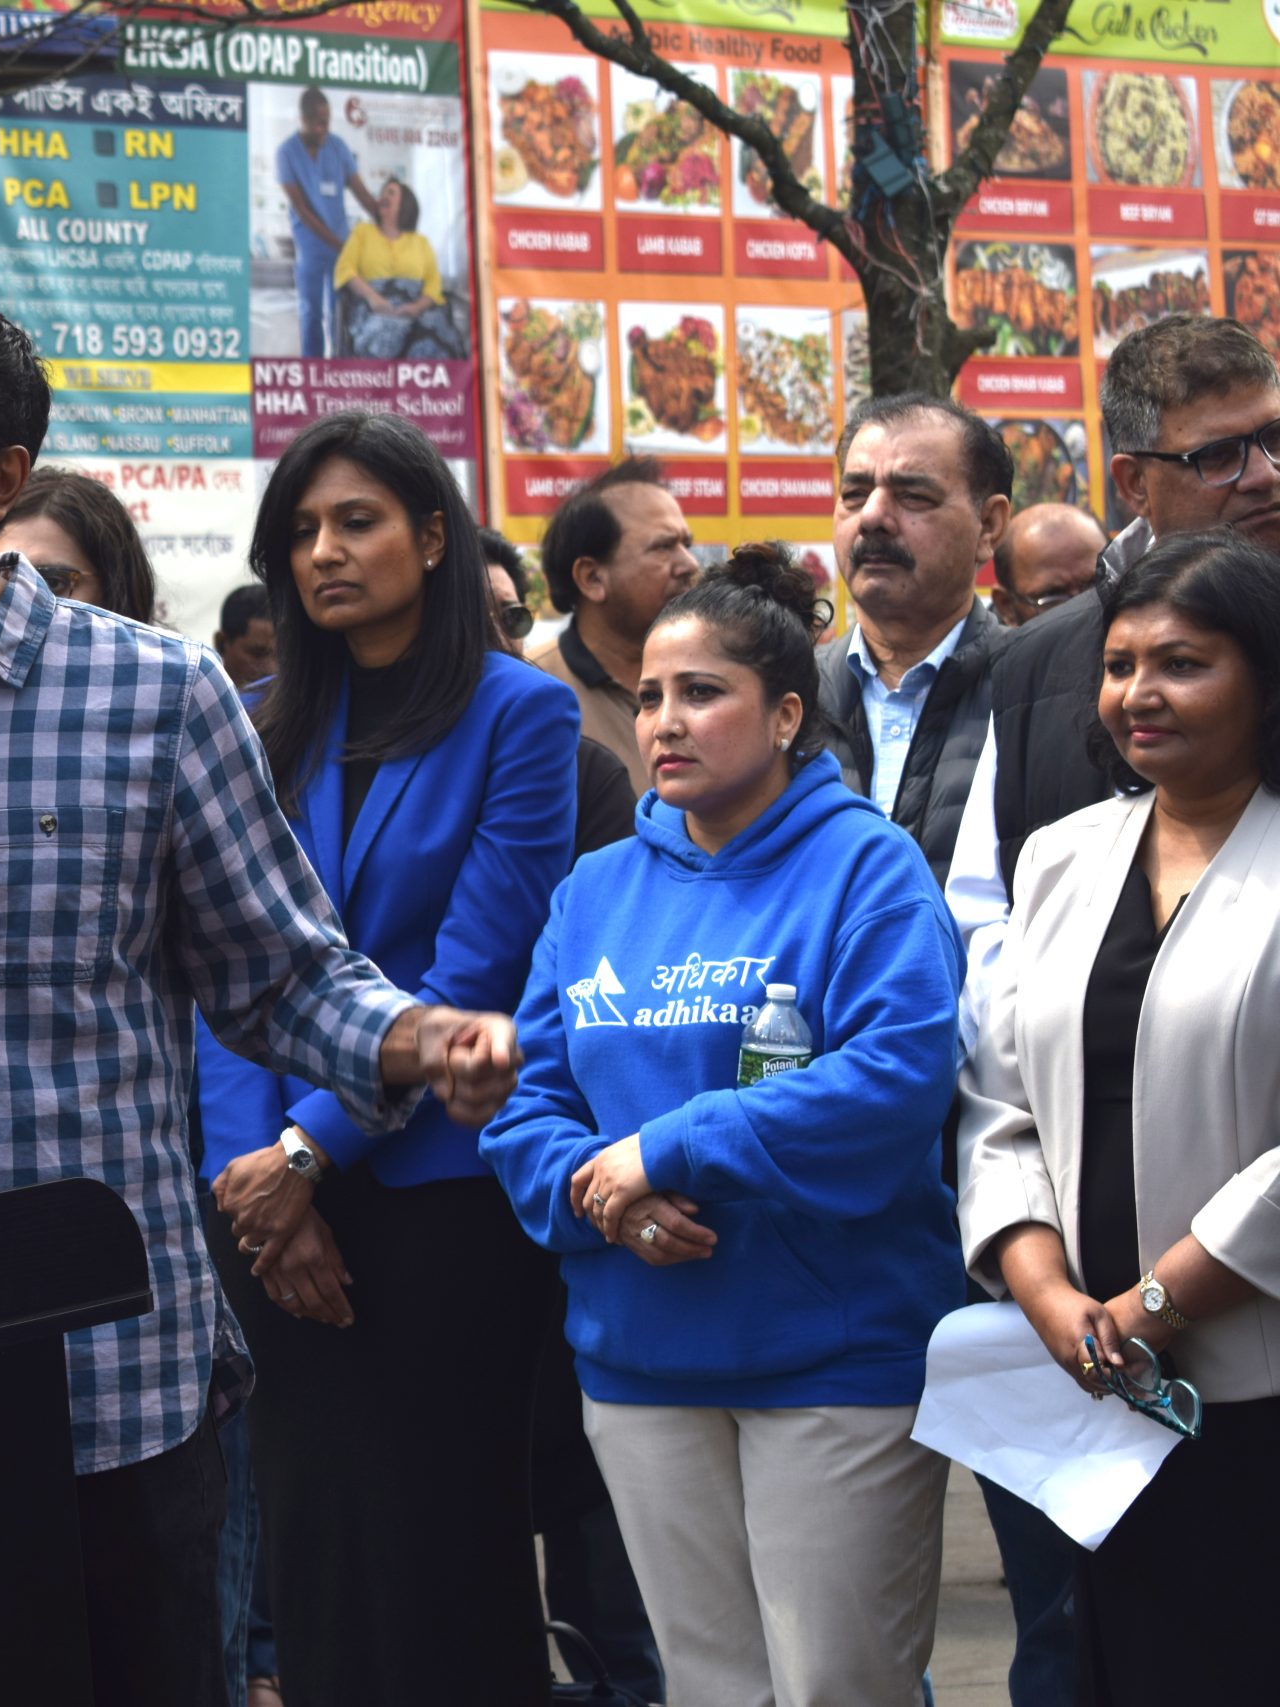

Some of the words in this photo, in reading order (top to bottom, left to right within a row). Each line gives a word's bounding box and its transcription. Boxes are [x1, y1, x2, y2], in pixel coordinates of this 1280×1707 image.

[608, 24, 682, 53] Abic
[689, 28, 764, 62] Healthy
[771, 37, 822, 64] Food
[304, 37, 429, 92] Transition)
[124, 129, 174, 160] RN
[3, 177, 70, 210] PCA
[129, 181, 196, 212] LPN
[16, 218, 50, 243] ALL
[57, 219, 149, 246] COUNTY
[51, 323, 104, 355] 718
[112, 324, 163, 357] 593
[172, 326, 241, 359] 0932
[254, 362, 304, 388] NYS
[308, 364, 395, 389] Licensed
[397, 364, 451, 389] PCA
[50, 402, 112, 424] ROOKLYN
[118, 403, 165, 425] BRONX
[171, 405, 249, 426] MANHATTAN
[255, 390, 308, 416] HHA
[395, 391, 464, 417] School
[106, 433, 161, 453] NASSAU
[172, 434, 232, 454] SUFFOLK
[120, 463, 207, 491] PCA/PA
[651, 952, 776, 995] अधिकार
[633, 995, 760, 1028] adhikaa
[762, 1057, 798, 1074] Poland
